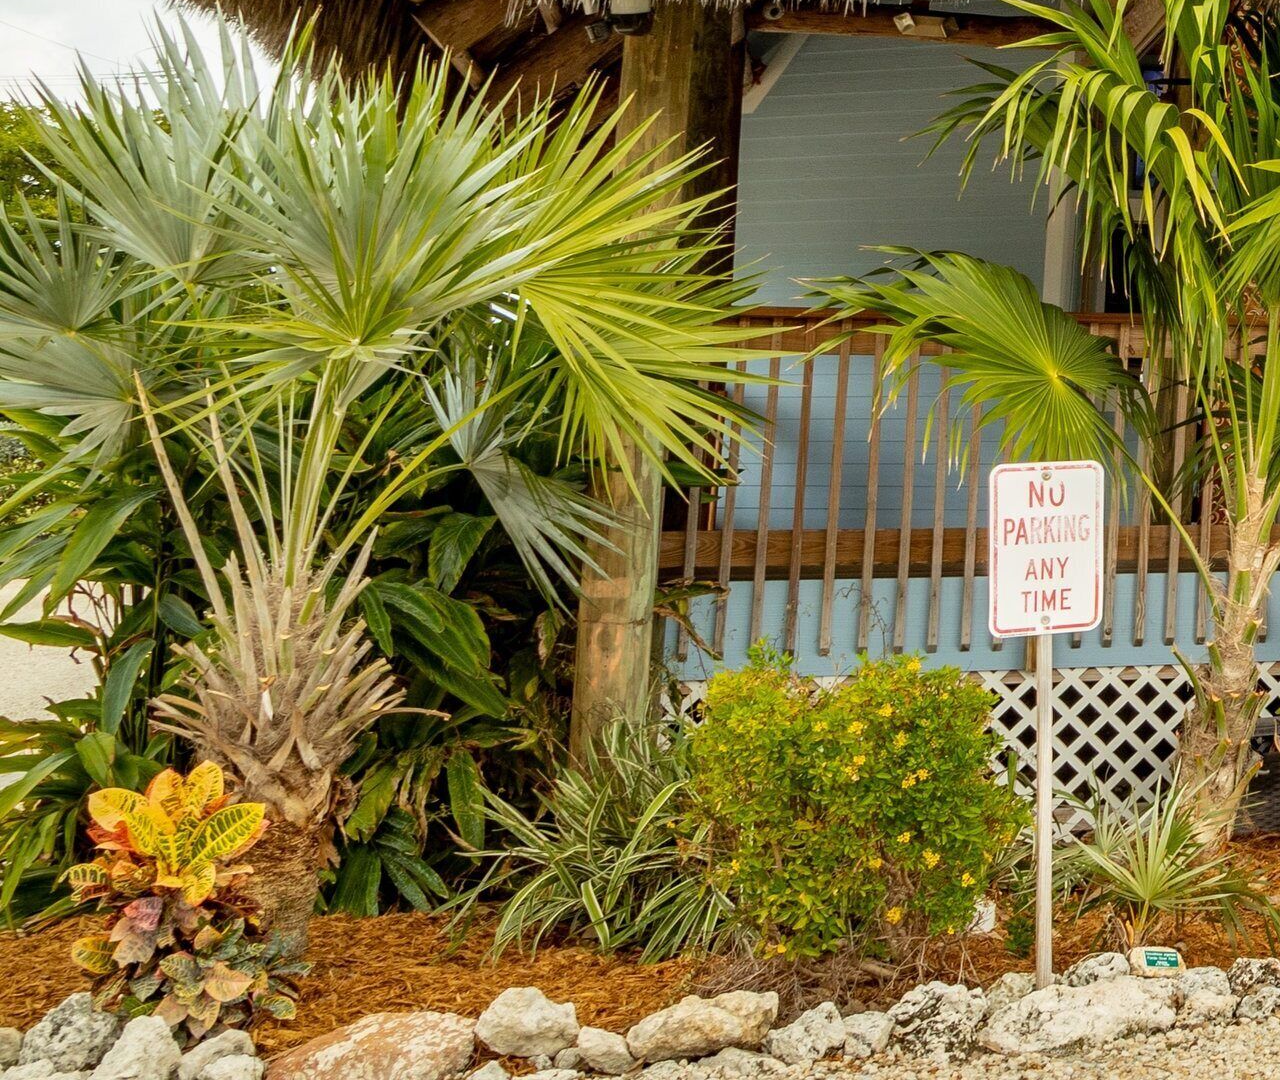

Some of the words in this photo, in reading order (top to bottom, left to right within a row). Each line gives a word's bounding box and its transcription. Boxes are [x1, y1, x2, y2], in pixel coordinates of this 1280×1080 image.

[1028, 480, 1066, 508] NO
[1003, 515, 1091, 546] PARKING
[1025, 557, 1069, 581] ANY
[1021, 588, 1072, 613] TIME
